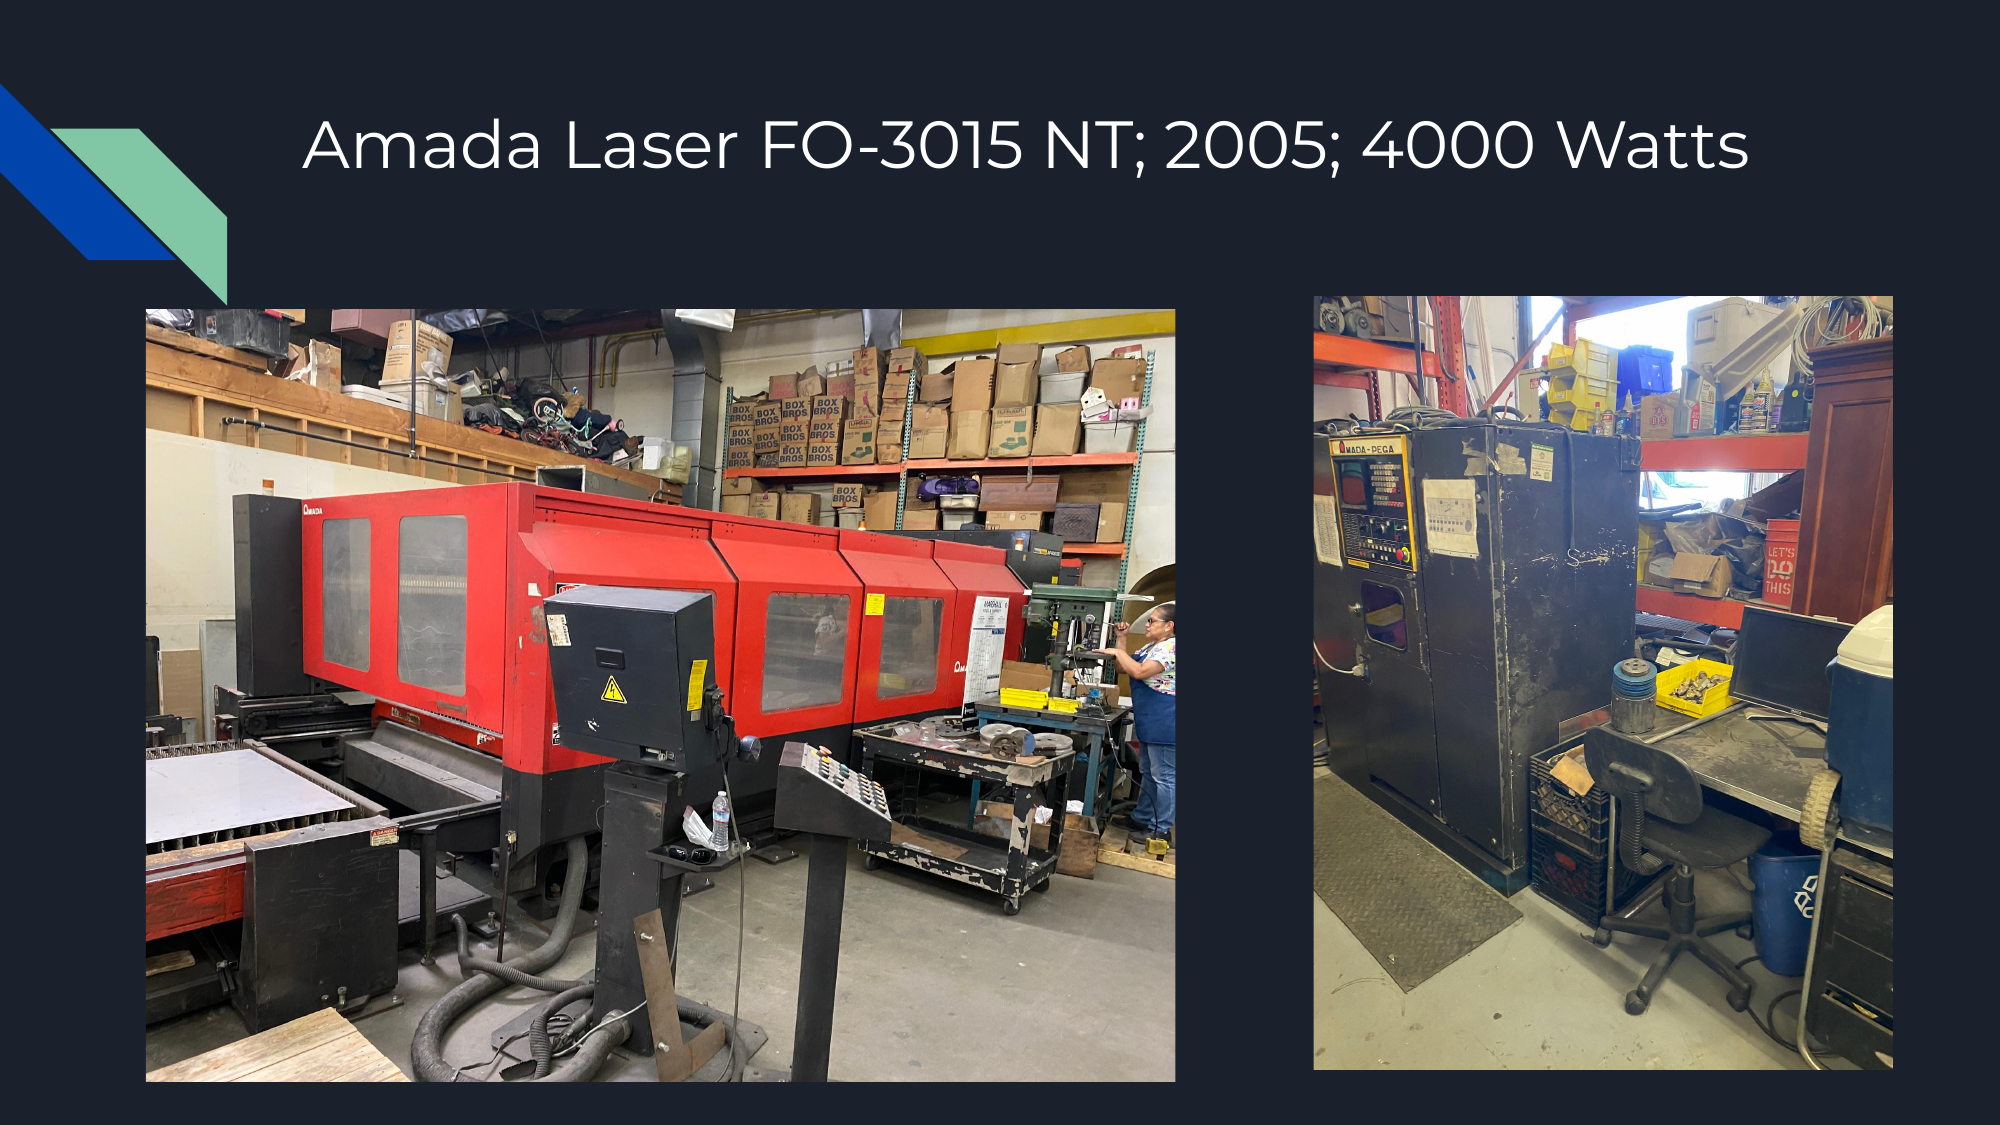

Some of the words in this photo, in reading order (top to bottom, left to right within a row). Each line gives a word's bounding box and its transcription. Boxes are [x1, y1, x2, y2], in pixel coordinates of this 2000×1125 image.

[785, 400, 805, 410] BOX
[817, 398, 837, 407] BOX
[732, 405, 750, 414] BOX
[757, 408, 776, 418] BOX
[782, 408, 808, 418] BROS
[813, 406, 840, 415] BROS
[730, 414, 754, 423] BROS
[754, 415, 780, 426] BROS
[783, 424, 802, 433] BOX
[813, 422, 834, 431] BOX
[732, 429, 750, 437] BOX
[757, 432, 775, 442] BOX
[780, 432, 806, 441] BROS
[809, 430, 836, 439] BROS
[729, 437, 753, 446] BROS
[754, 440, 779, 450] BROS
[782, 446, 802, 455] BOX
[811, 445, 831, 453] BOX
[731, 451, 749, 459] BOX
[779, 454, 804, 463] BROS
[808, 453, 834, 462] BROS
[728, 459, 751, 467] BROS
[836, 486, 857, 495] BOX
[832, 494, 859, 503] BROS
[1768, 546, 1795, 558] LET'S
[1767, 559, 1794, 580] DO
[1766, 581, 1791, 595] THIS
